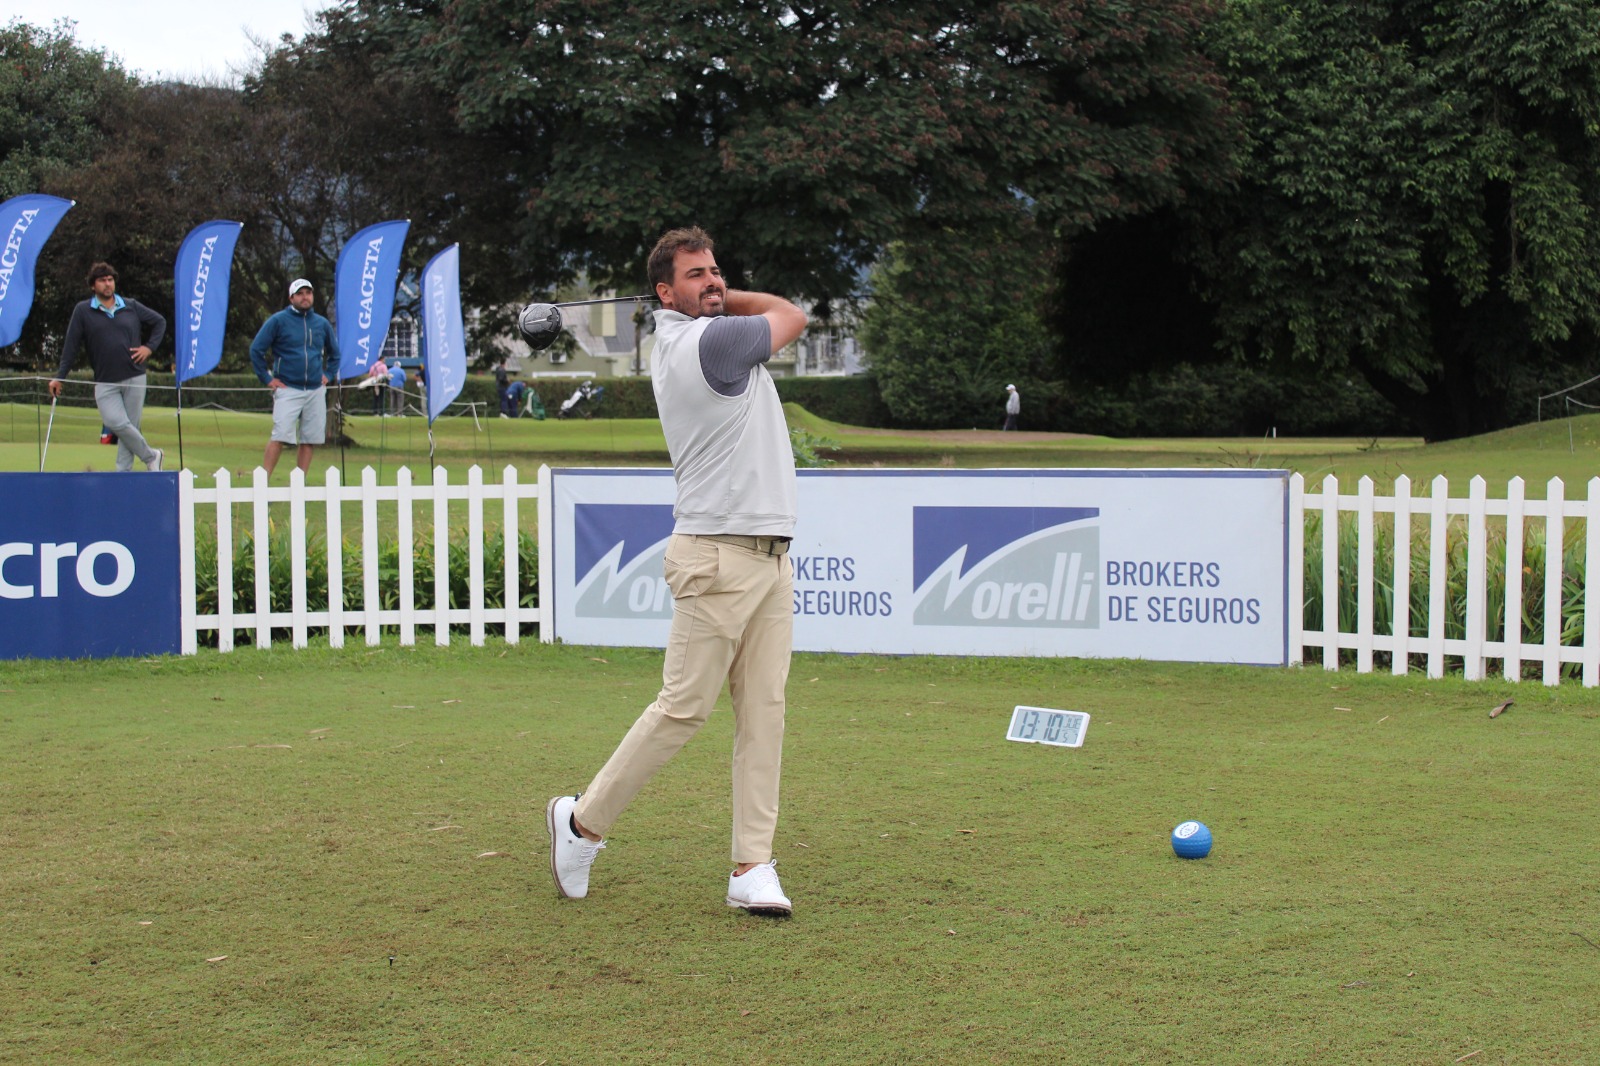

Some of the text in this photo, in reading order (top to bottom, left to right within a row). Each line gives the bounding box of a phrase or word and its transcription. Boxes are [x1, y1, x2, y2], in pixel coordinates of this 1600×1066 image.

[190, 235, 219, 331] GACETA
[355, 236, 384, 367] LA GACETA
[790, 556, 856, 581] KERS
[1106, 560, 1221, 588] BROKERS
[793, 589, 893, 617] SEGUROS
[1108, 595, 1261, 625] DE SEGUROS
[1019, 711, 1063, 741] 13:10
